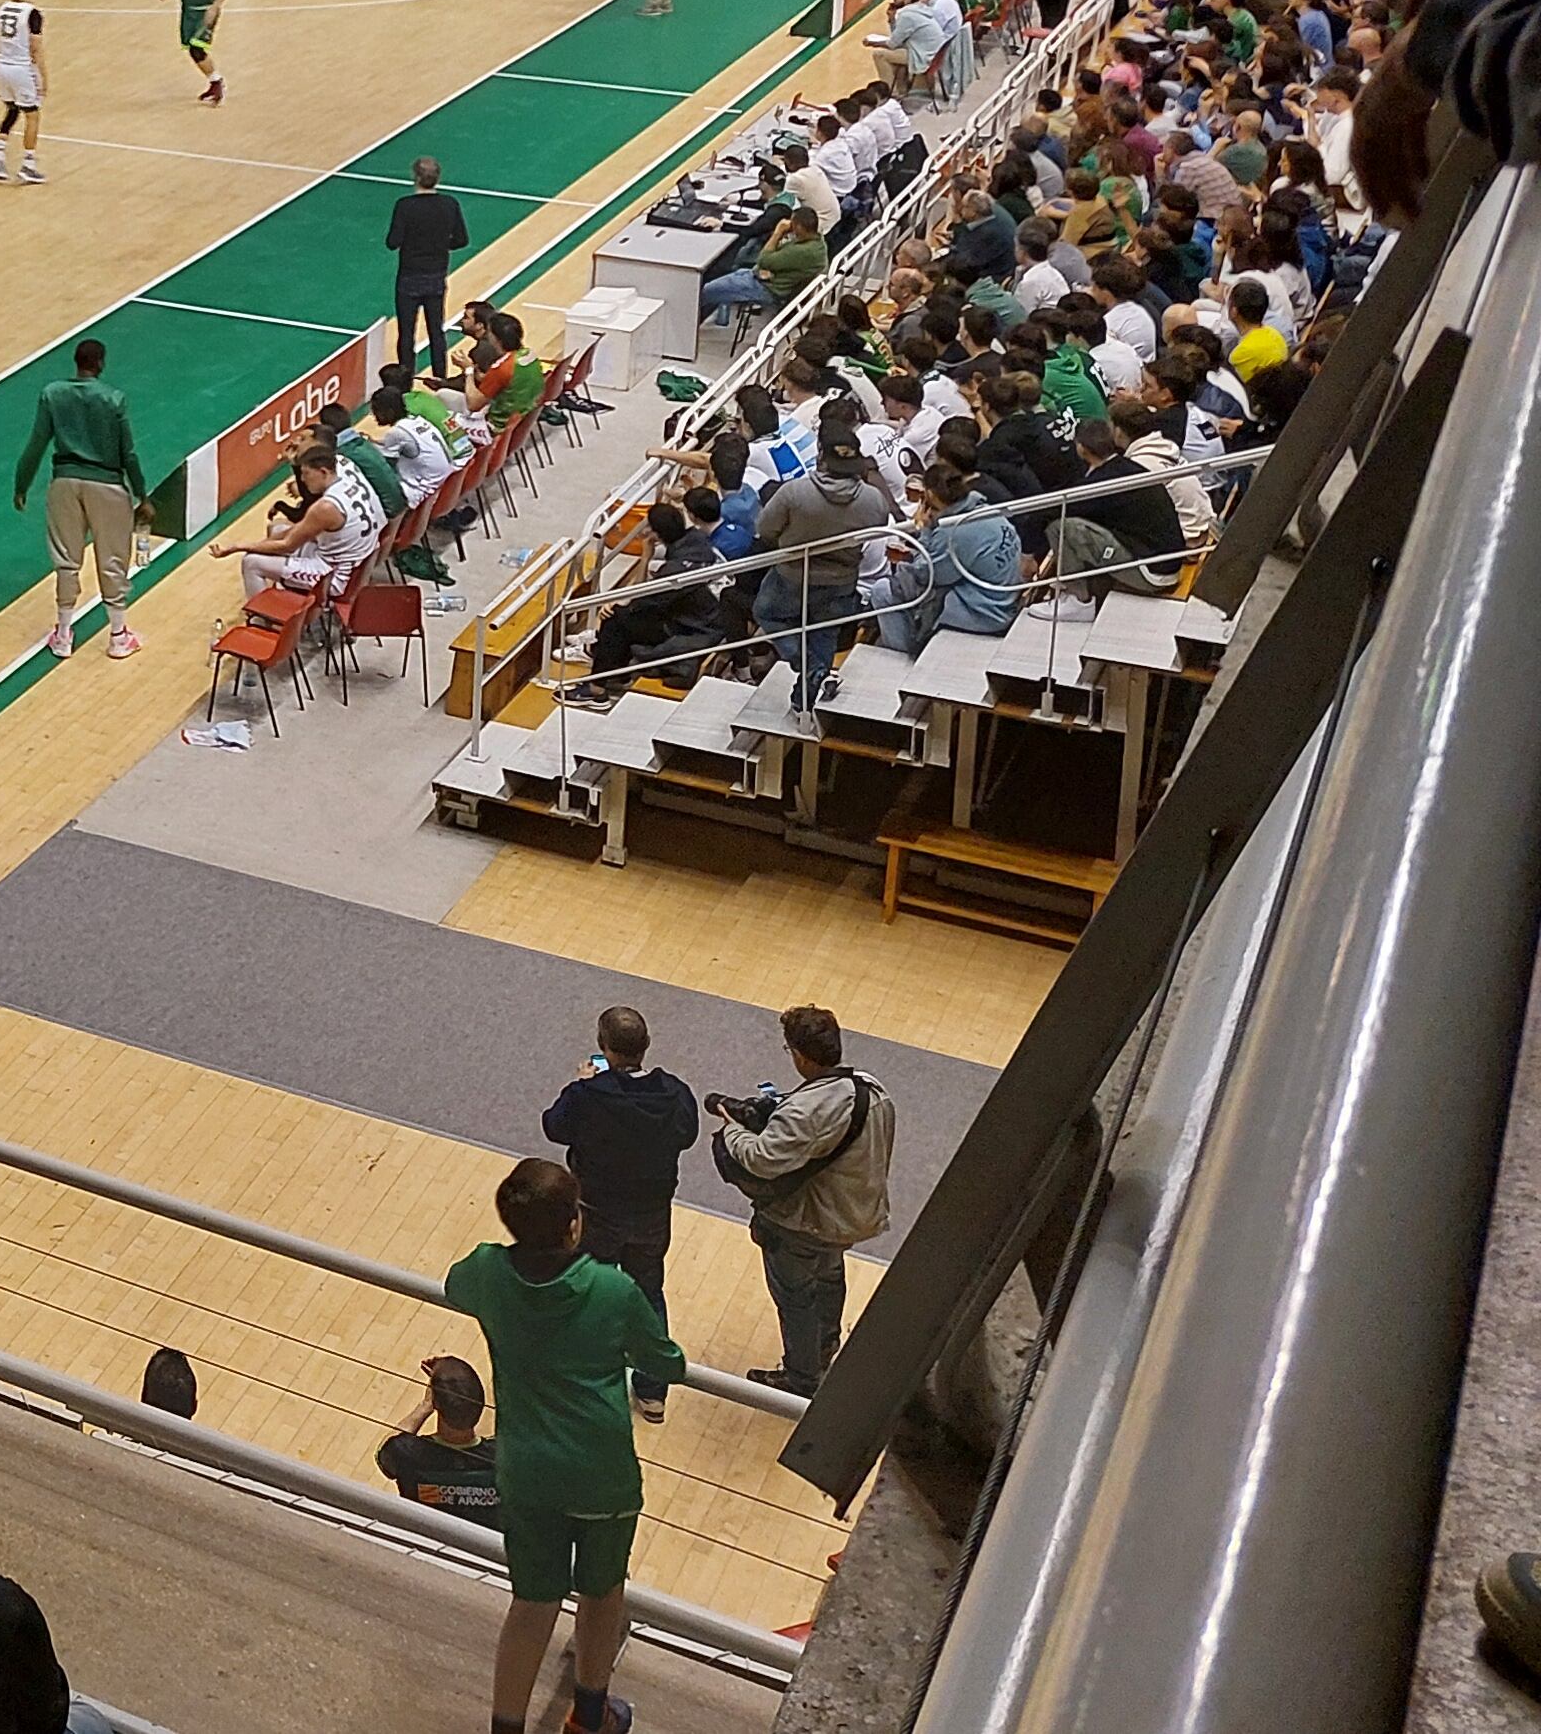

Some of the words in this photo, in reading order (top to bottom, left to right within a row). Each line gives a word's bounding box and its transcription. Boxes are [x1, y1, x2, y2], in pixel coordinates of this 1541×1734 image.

[274, 375, 340, 443] Lobe
[439, 1486, 496, 1497] GOBIERNO
[439, 1496, 454, 1505] DE
